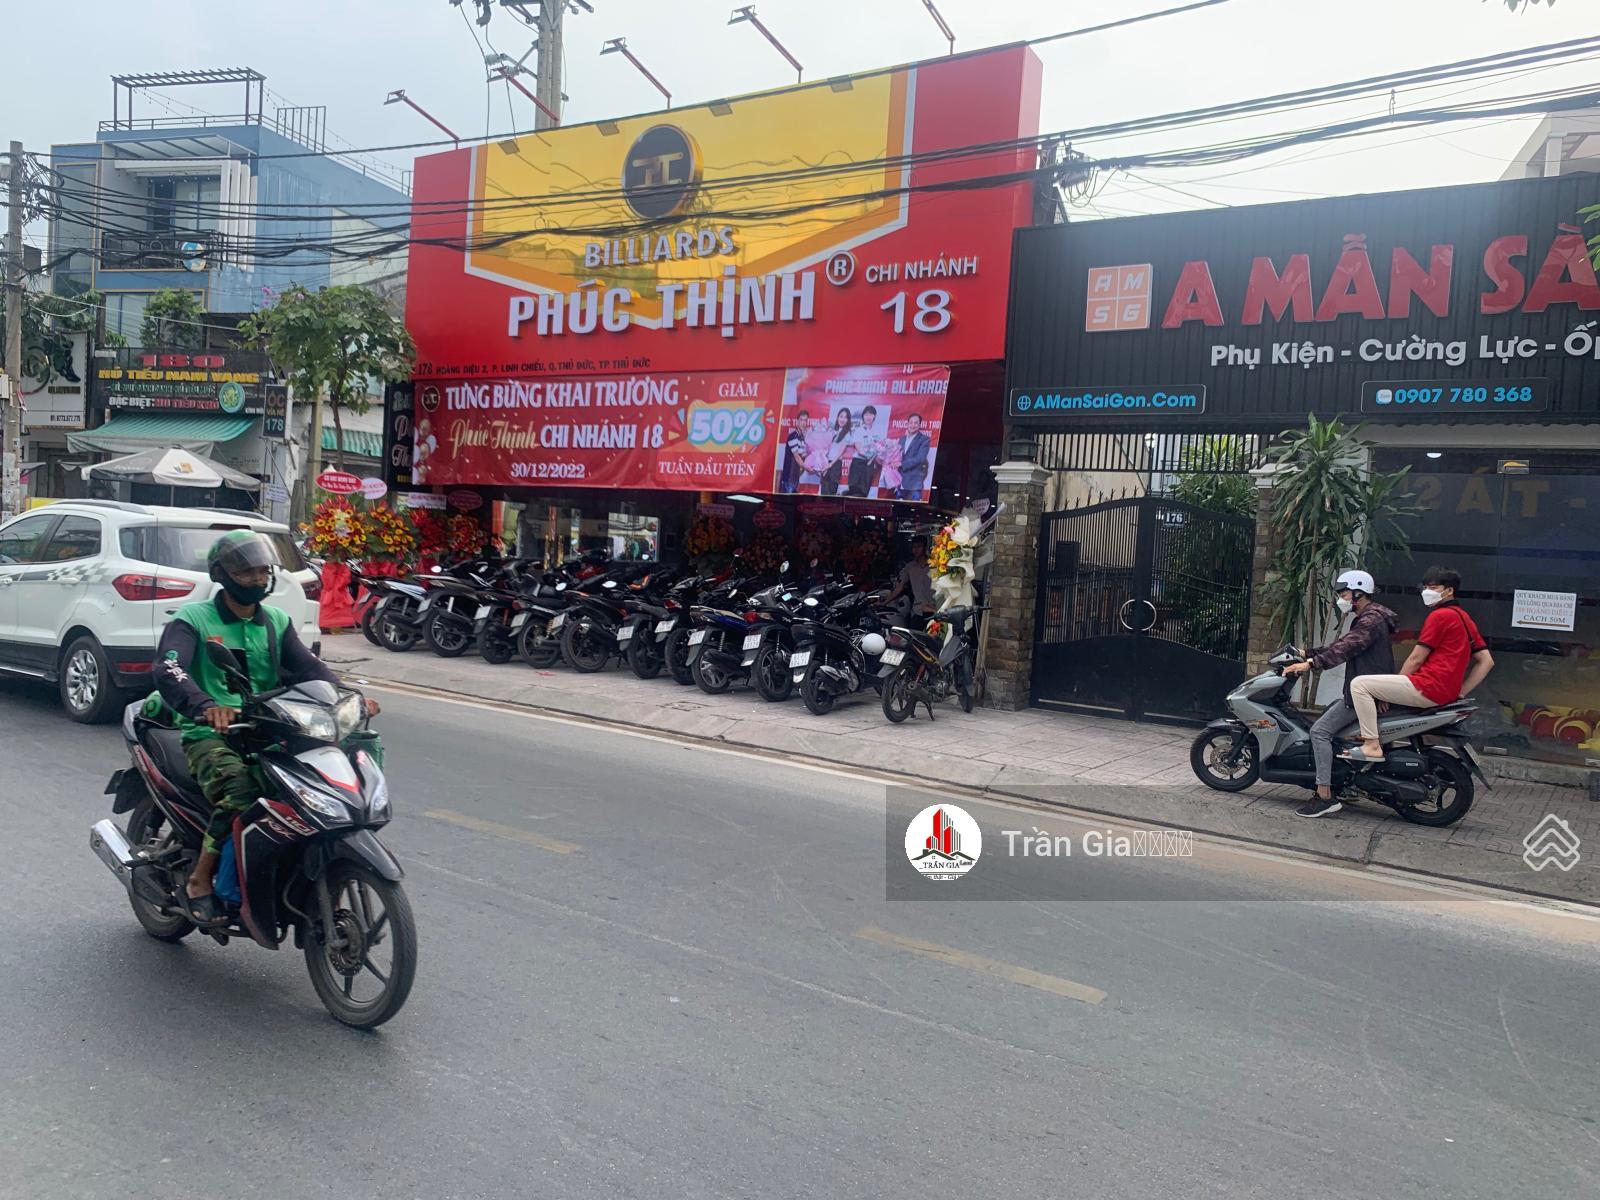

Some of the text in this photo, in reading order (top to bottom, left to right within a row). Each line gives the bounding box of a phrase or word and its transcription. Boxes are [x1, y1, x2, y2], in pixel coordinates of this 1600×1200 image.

[585, 226, 734, 268] BILLIARDS
[866, 252, 978, 284] CHI NHÁNH
[1161, 260, 1224, 329] A
[1241, 232, 1454, 325] MÃN
[508, 279, 632, 336] PHÚC
[656, 265, 816, 337] THỊNH
[880, 289, 951, 334] 18
[1211, 344, 1260, 370] Phụ
[1272, 340, 1334, 369] Kiện
[1359, 334, 1467, 366] Cường
[1480, 335, 1538, 364] Lực
[1564, 320, 1600, 360] Ố
[501, 364, 518, 373] LINH
[632, 356, 652, 368] ĐỨC
[166, 370, 207, 382] NAM
[211, 372, 259, 383] VANG
[492, 379, 542, 408] BỪNG
[545, 382, 590, 408] KHAI
[594, 376, 679, 407] TRƯƠNG
[718, 377, 759, 398] GIẢM
[1395, 388, 1443, 404] 0907
[1450, 387, 1487, 403] 780
[1494, 386, 1532, 402] 368
[109, 394, 128, 408] ĐẶC
[1033, 392, 1196, 410] AManSaiGon.Com
[266, 418, 284, 431] 178
[689, 409, 763, 444] 50%
[448, 418, 662, 459] Phúc Thịnh CHI NHÁNH 18
[511, 463, 586, 479] 30/12/2022
[658, 456, 755, 476] TUẦN ĐẦU TIÊN
[1166, 512, 1183, 522] 176
